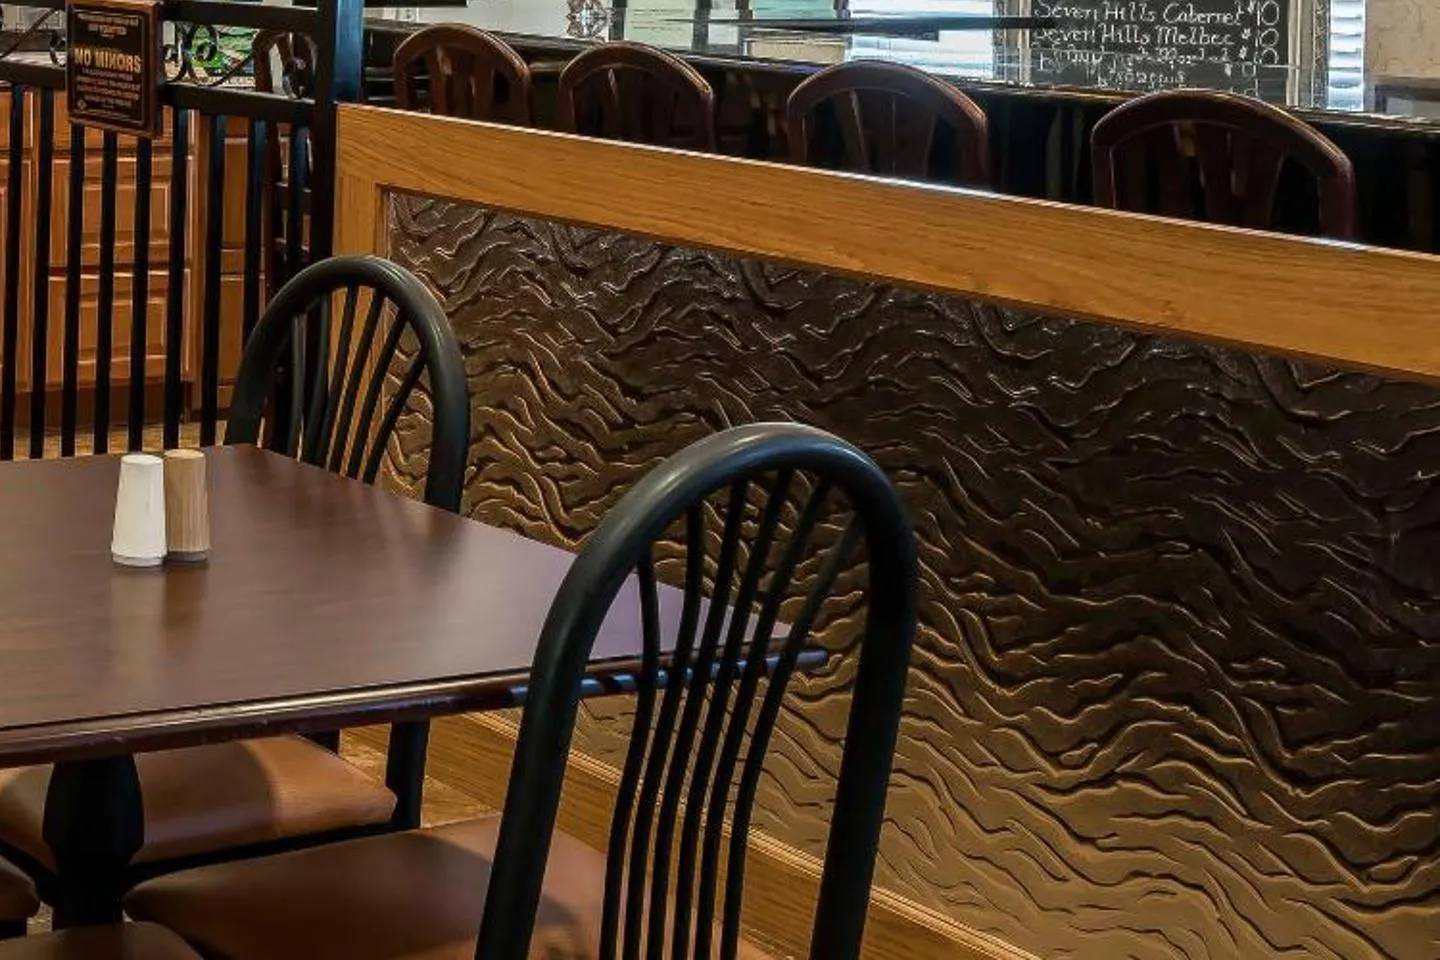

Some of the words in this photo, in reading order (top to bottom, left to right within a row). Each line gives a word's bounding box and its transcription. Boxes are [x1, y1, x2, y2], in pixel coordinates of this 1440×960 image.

[1102, 0, 1156, 22] Hills
[1098, 22, 1152, 44] Hills
[74, 47, 92, 66] NO
